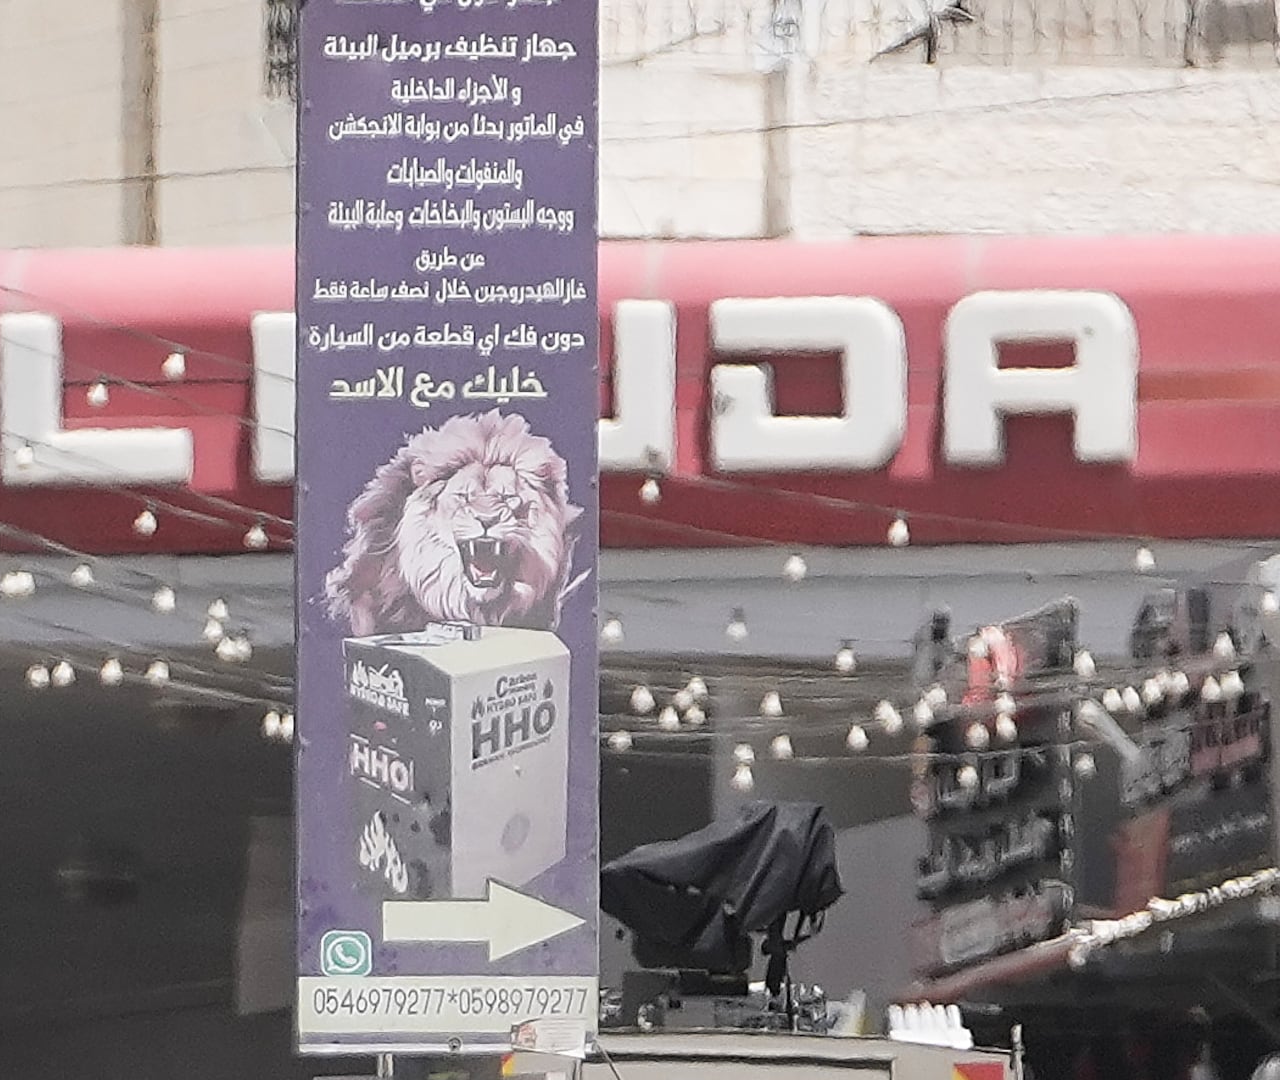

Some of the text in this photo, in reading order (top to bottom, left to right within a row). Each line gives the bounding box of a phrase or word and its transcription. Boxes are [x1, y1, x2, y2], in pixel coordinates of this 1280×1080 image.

[323, 33, 577, 63] جهاز تنظيف برميل البيئة
[391, 77, 455, 104] الداخلية
[404, 112, 441, 142] بوابة
[442, 121, 470, 143] من
[558, 115, 584, 146] في
[327, 199, 364, 230] البيئة
[365, 199, 404, 232] وعلبة
[482, 199, 535, 232] البستون
[536, 207, 574, 232] ووجه
[415, 246, 485, 272] عن طريق
[312, 278, 348, 300] فقط
[349, 278, 389, 302] ساعة
[390, 280, 429, 299] نصف
[435, 277, 472, 304] خلال
[308, 322, 585, 356] دون فك اي قطعة من السيارة
[329, 365, 548, 408] خليك مع الاسد
[471, 701, 556, 760] HHO
[349, 742, 409, 792] HHO
